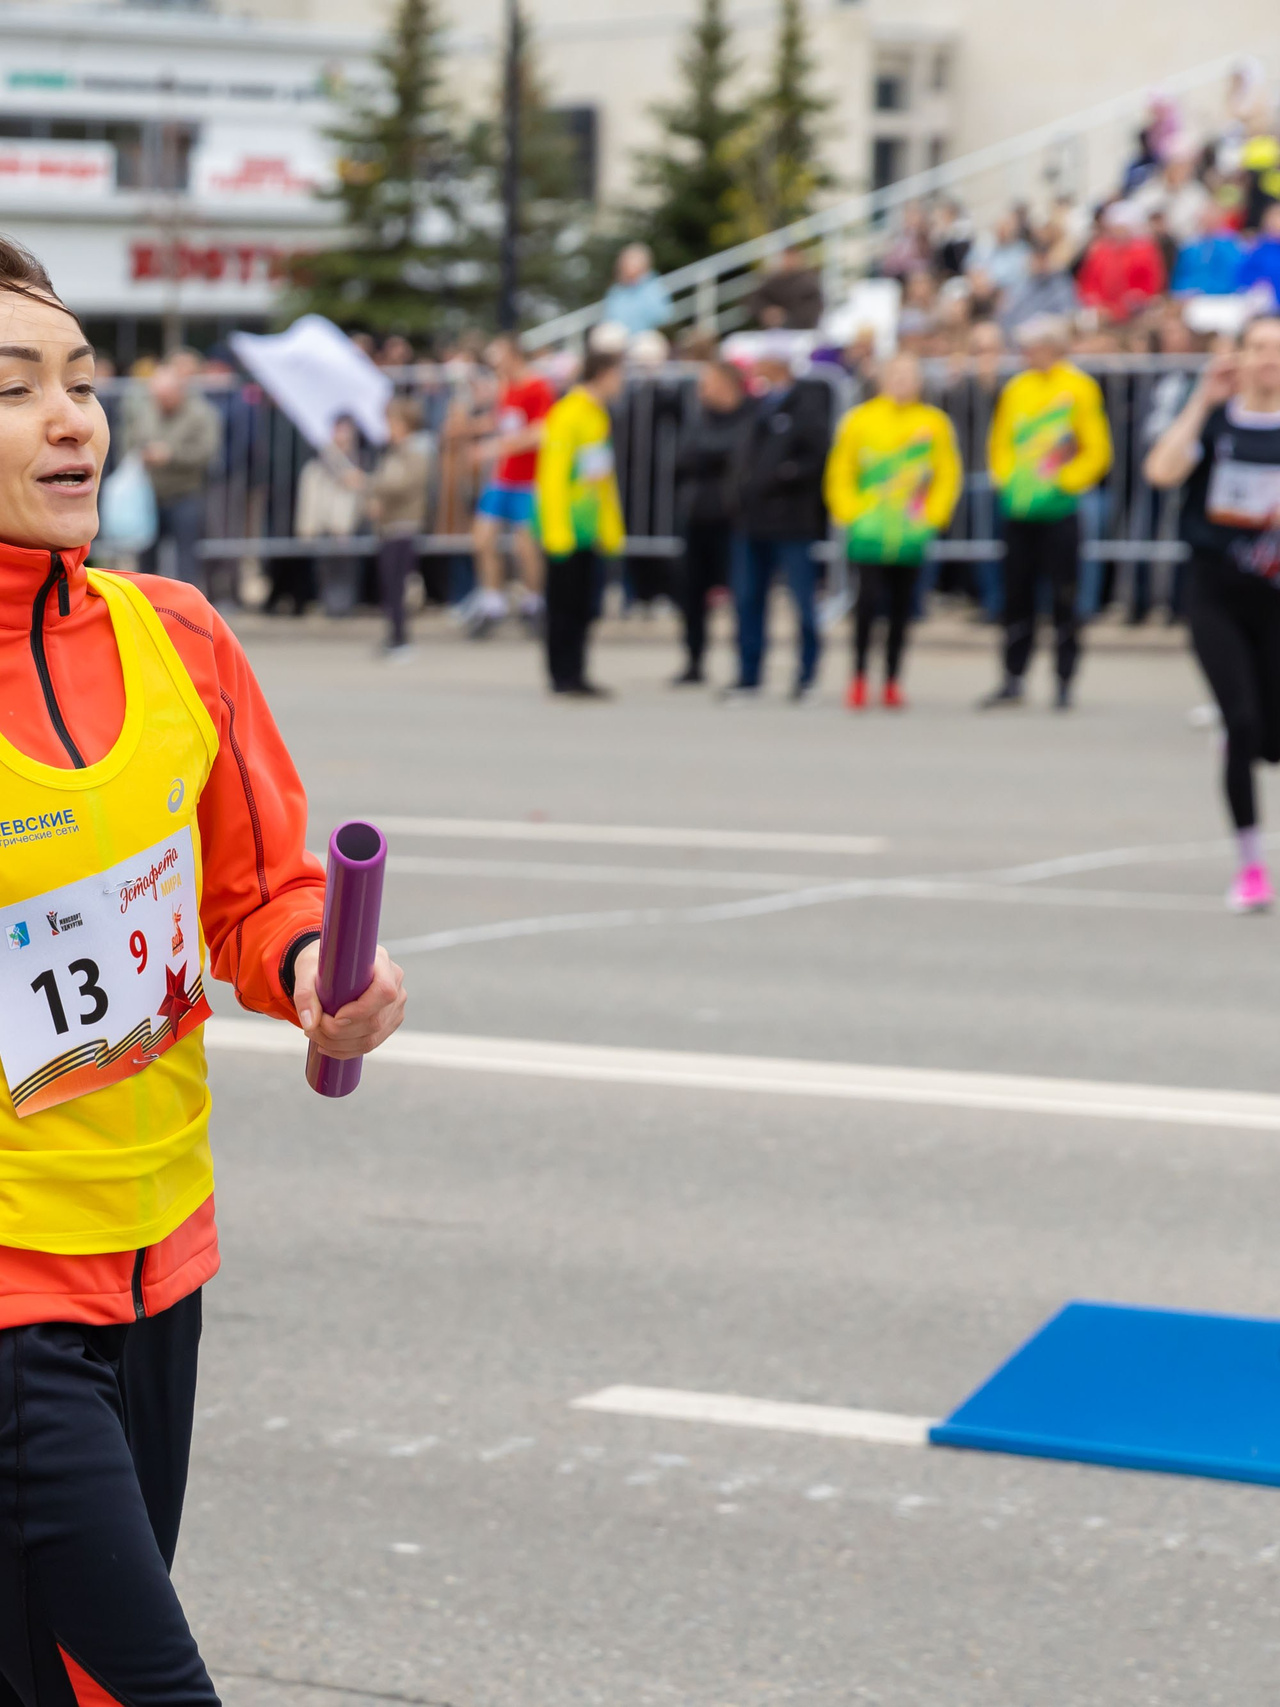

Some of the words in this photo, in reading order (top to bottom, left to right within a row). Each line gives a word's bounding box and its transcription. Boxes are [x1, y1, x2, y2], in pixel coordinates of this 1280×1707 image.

[55, 825, 80, 838] сети
[120, 848, 178, 914] Эстафета
[160, 872, 182, 897] МИРА
[129, 930, 148, 975] 9
[30, 958, 109, 1035] 13
